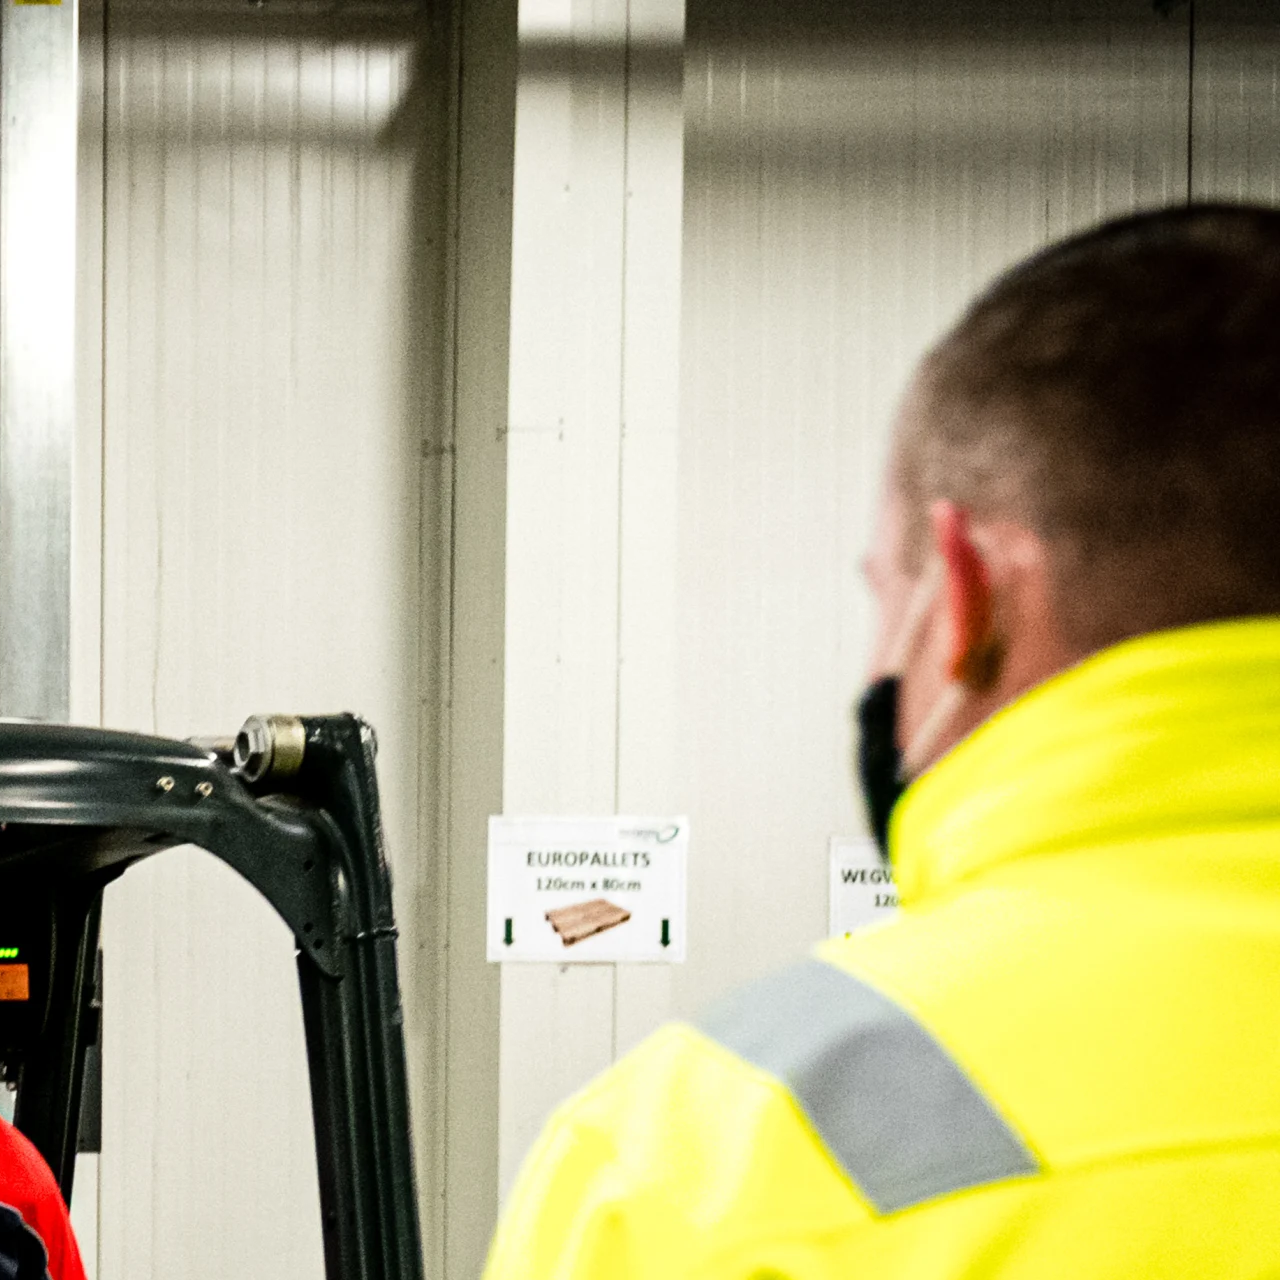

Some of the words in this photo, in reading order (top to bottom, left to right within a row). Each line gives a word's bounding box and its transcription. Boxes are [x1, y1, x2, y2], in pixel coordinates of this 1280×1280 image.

[526, 851, 651, 868] EUROPALLETS
[536, 877, 585, 891] 120cm
[602, 877, 642, 891] 80cm
